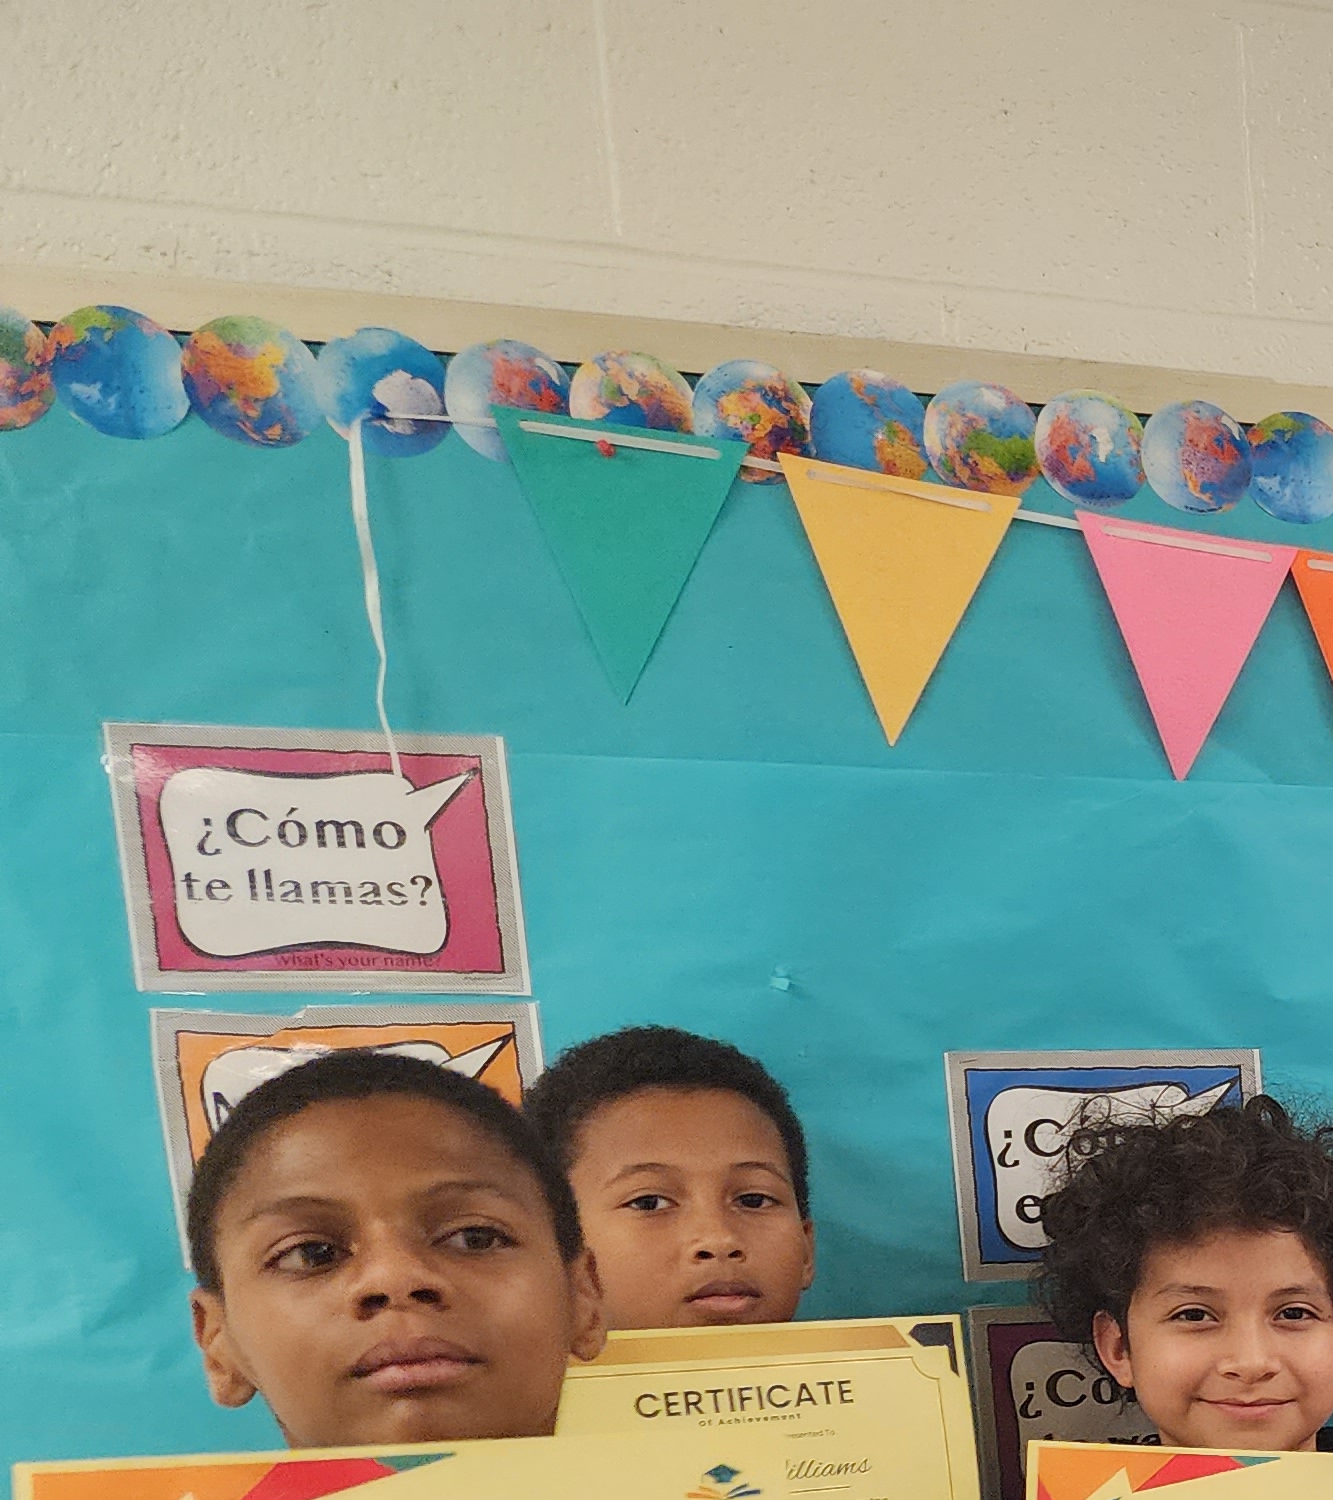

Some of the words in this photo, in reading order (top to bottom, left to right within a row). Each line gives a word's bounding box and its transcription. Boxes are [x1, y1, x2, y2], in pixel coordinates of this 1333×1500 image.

[197, 806, 407, 856] ¿Cómo
[180, 872, 233, 902] te
[248, 868, 432, 906] llamas?
[338, 957, 377, 968] your
[634, 1379, 854, 1419] CERTIFICATE
[718, 1413, 801, 1425] Achievement
[785, 1457, 872, 1480] illiams
